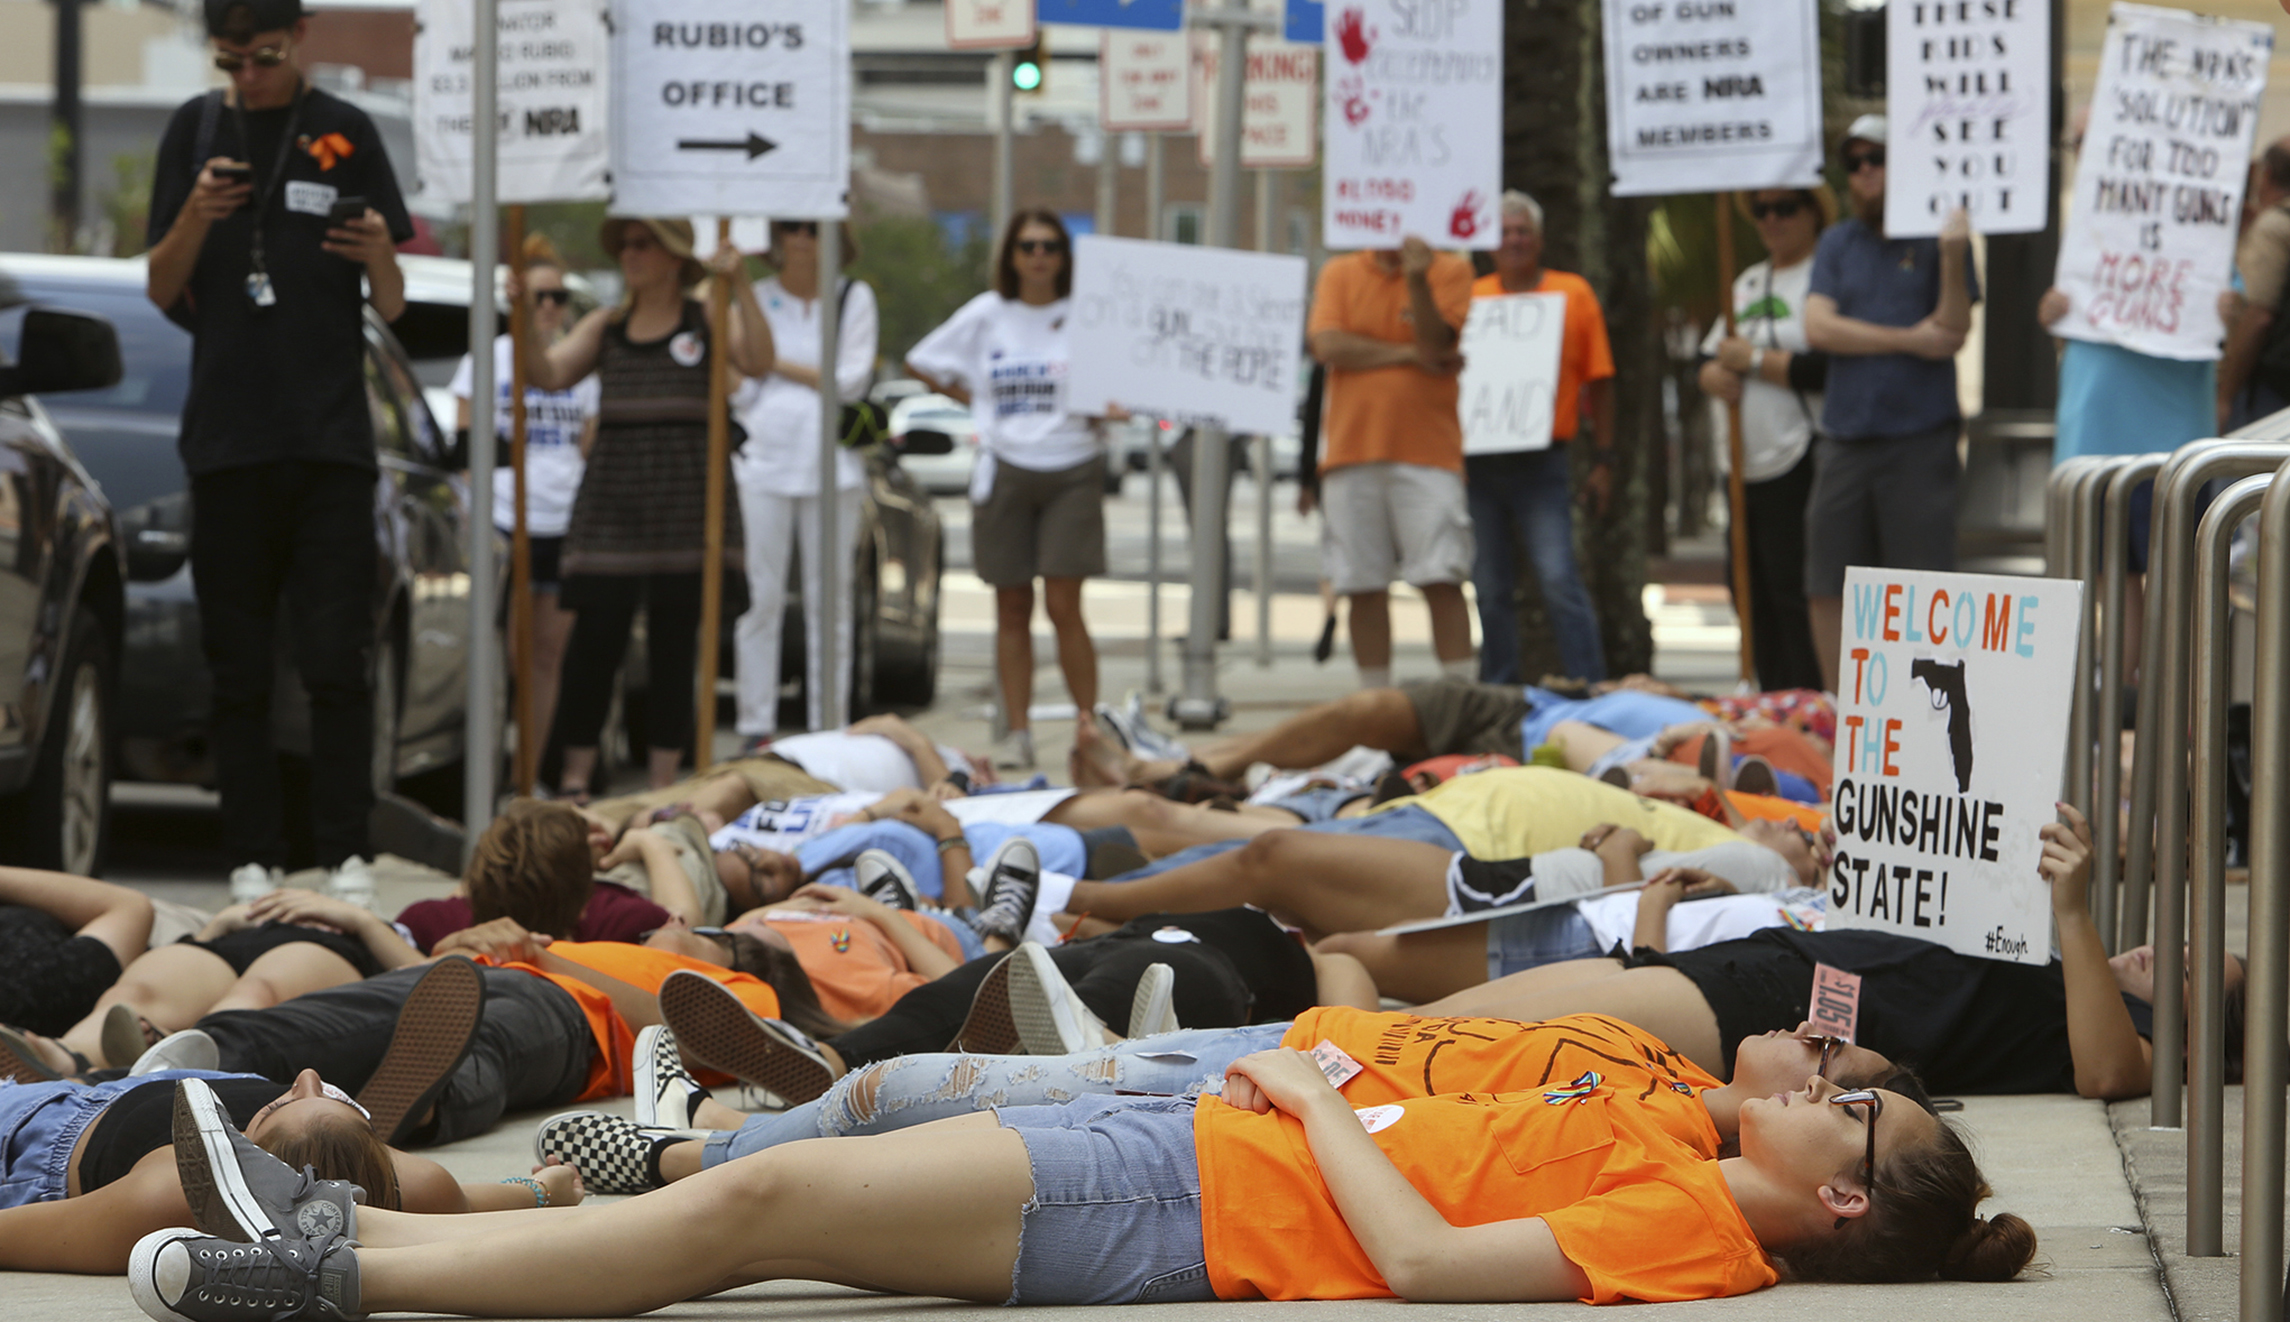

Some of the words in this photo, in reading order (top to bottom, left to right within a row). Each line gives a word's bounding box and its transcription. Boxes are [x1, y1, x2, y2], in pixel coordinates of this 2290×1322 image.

[1676, 3, 1736, 22] GUN
[652, 23, 805, 50] RUBIO'S
[1632, 38, 1751, 64] OWNERS
[1920, 32, 2007, 62] KIDS
[2121, 34, 2180, 79] THE
[661, 82, 796, 109] OFFICE
[1637, 81, 1688, 103] ARE
[1924, 70, 2013, 96] WILL
[1638, 120, 1773, 147] MEMBERS
[1932, 118, 2014, 144] SEE
[1932, 148, 2018, 182] YOU
[2108, 136, 2154, 172] FOR
[2168, 139, 2221, 178] TOO
[1927, 186, 2015, 216] OUT
[2139, 223, 2160, 250] IS
[2093, 251, 2194, 297] MORE
[2085, 290, 2183, 335] GUNS
[1853, 583, 2039, 658] WELCOME
[1850, 648, 1888, 707] TO
[1845, 715, 1902, 776] THE
[1835, 779, 2004, 862] GUNSHINE
[1832, 851, 1948, 928] STATE!
[1985, 925, 2028, 961] #Enough
[1815, 980, 1856, 1027] $1.05
